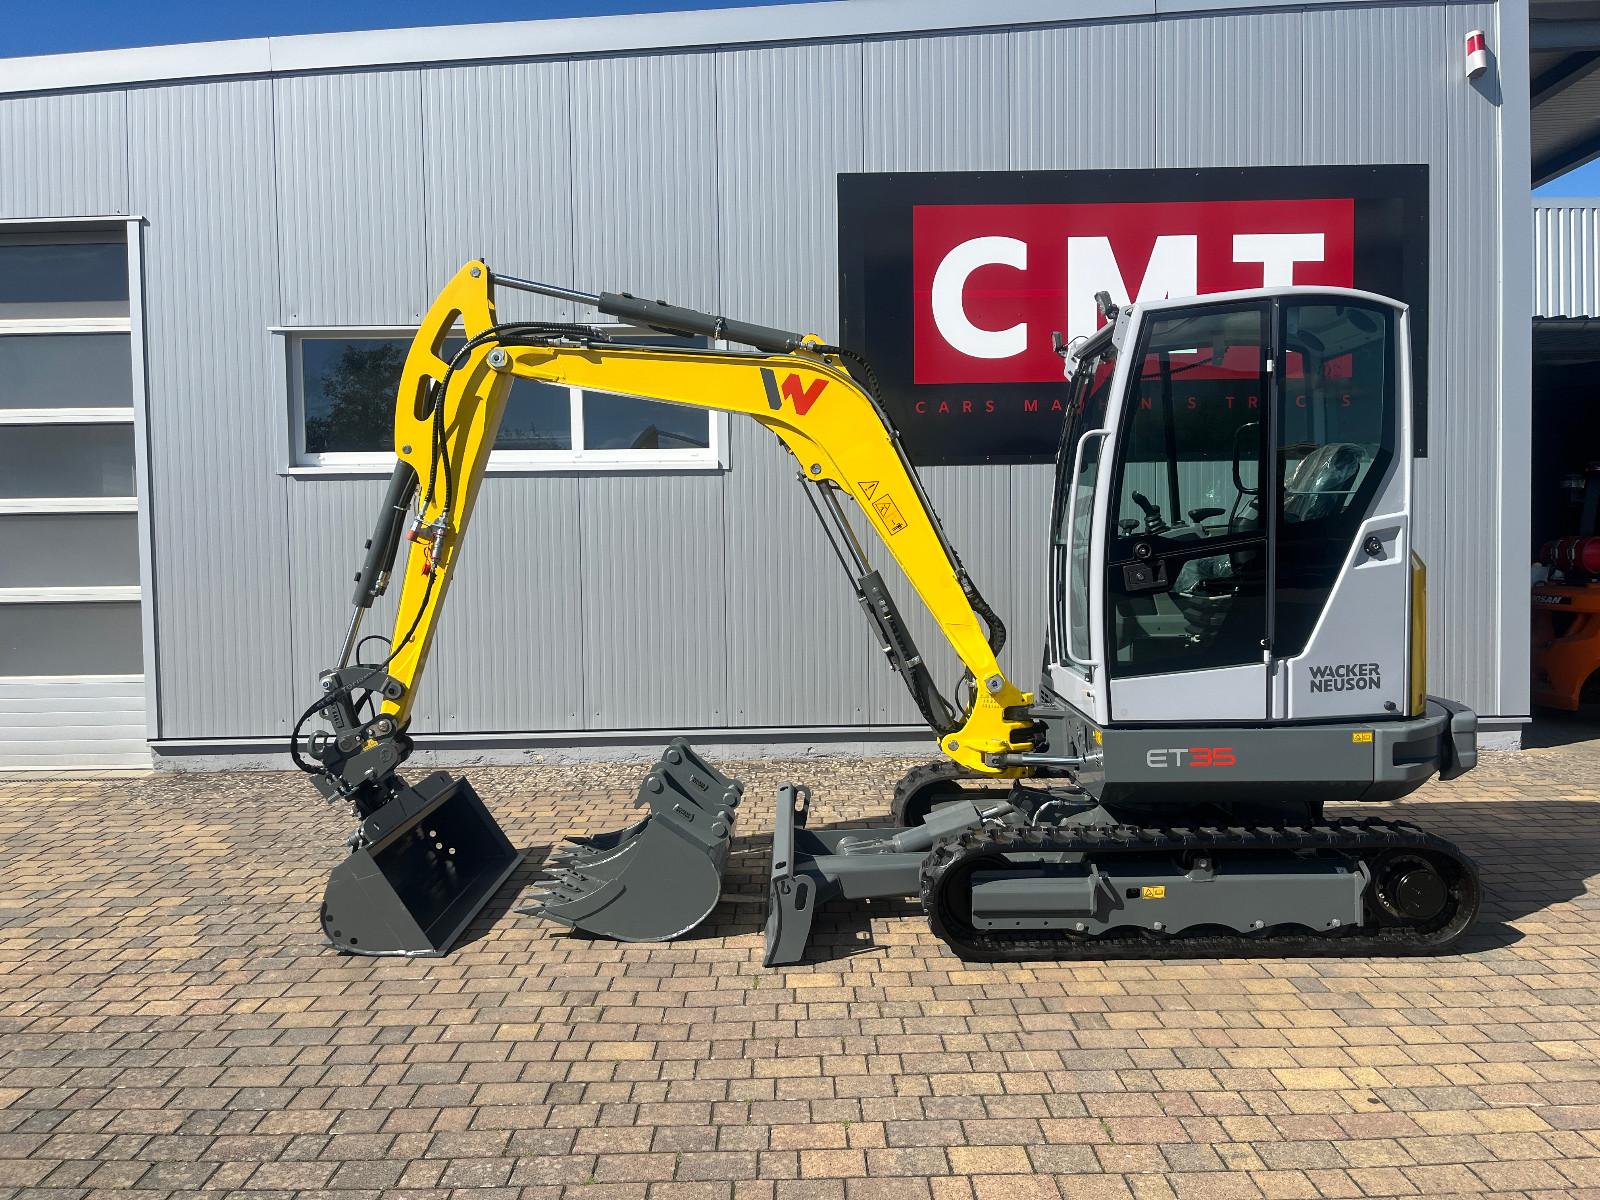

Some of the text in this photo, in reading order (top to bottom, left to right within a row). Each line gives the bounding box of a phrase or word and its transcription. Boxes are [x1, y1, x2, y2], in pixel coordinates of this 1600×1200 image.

[931, 233, 1325, 359] CMT
[916, 399, 996, 414] CARS
[1225, 392, 1353, 409] TRCS
[1309, 664, 1380, 678] WACKER
[1310, 677, 1381, 693] NEUSON
[1146, 748, 1236, 767] ET35
